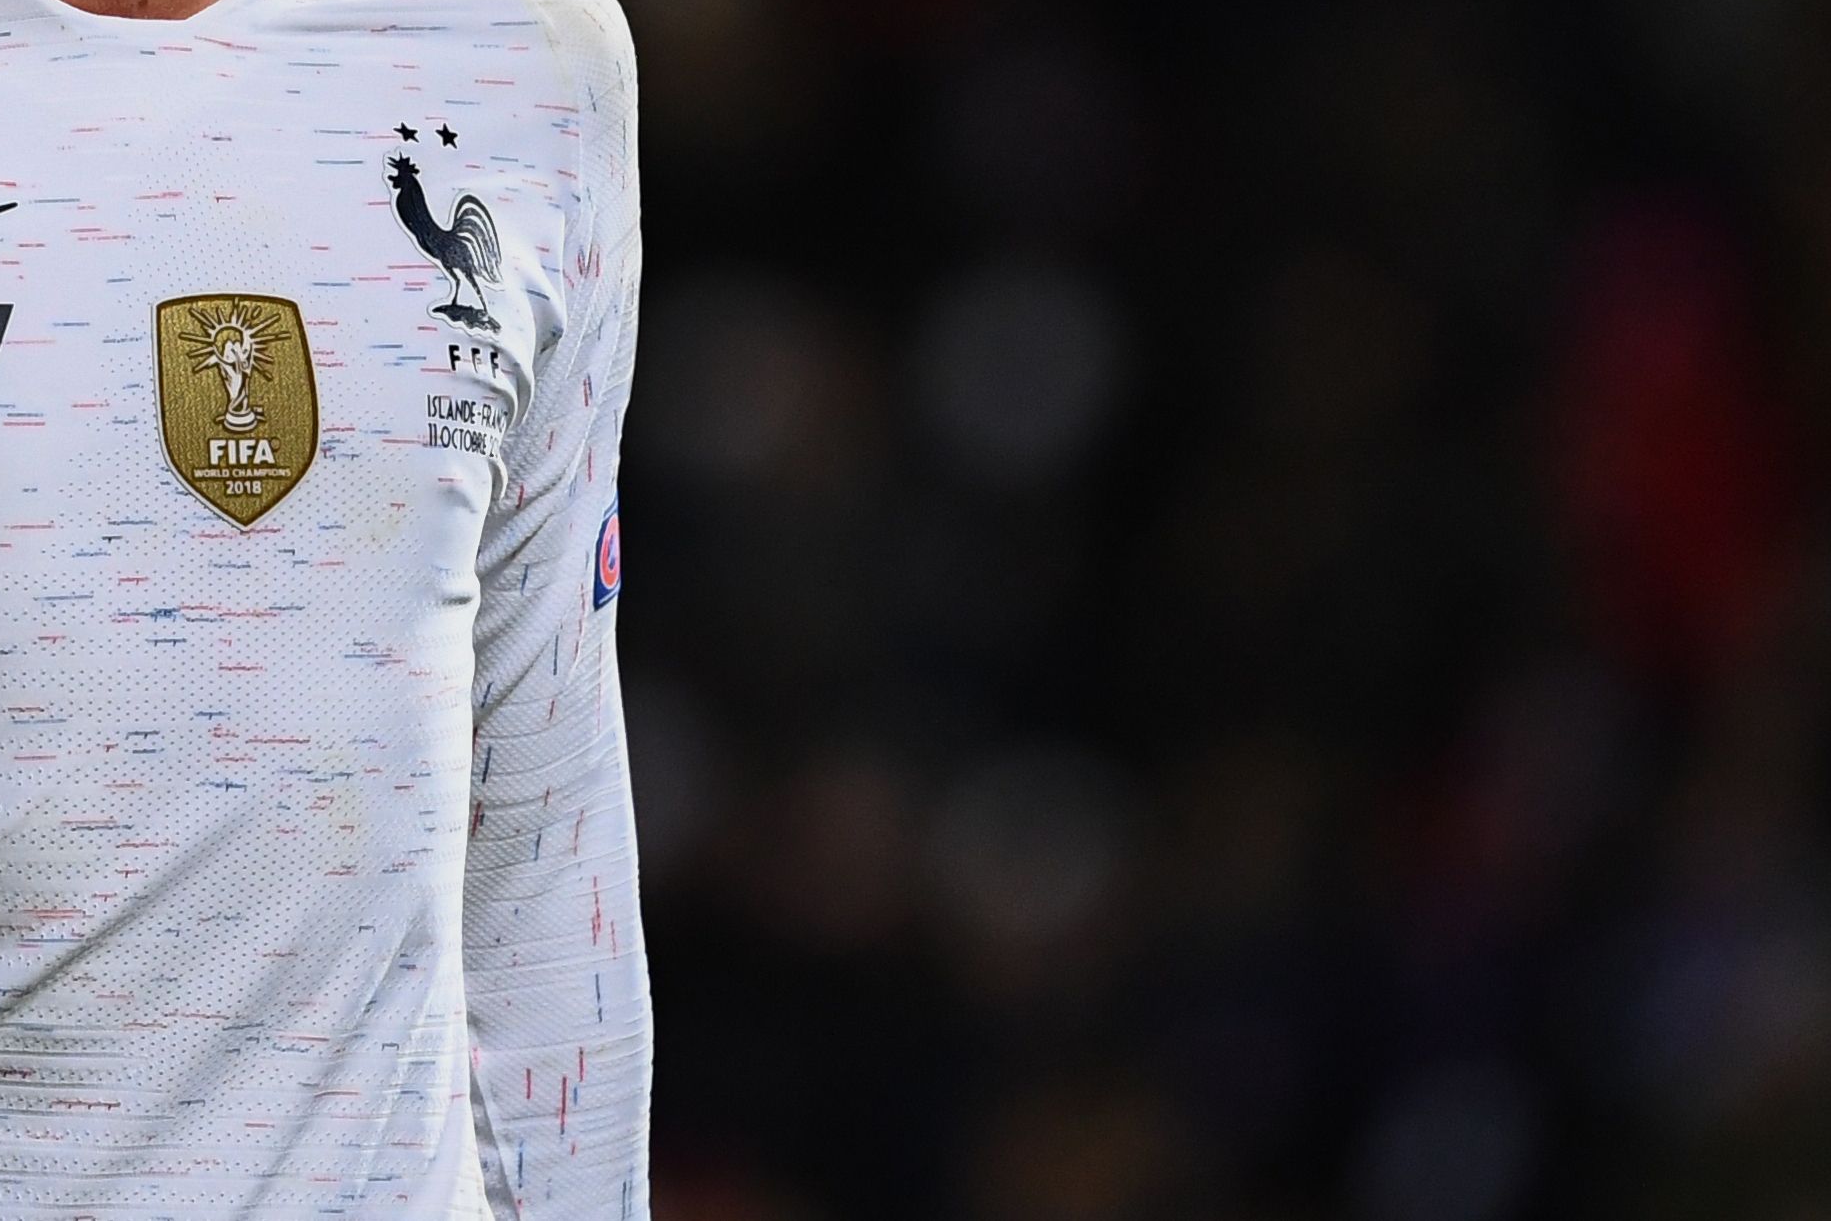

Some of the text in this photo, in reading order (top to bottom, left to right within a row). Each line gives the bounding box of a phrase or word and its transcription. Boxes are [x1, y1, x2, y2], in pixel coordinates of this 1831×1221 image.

[209, 439, 276, 465] FIFA
[193, 468, 292, 478] WORLD CHAMPIONS
[225, 480, 262, 495] 2018
